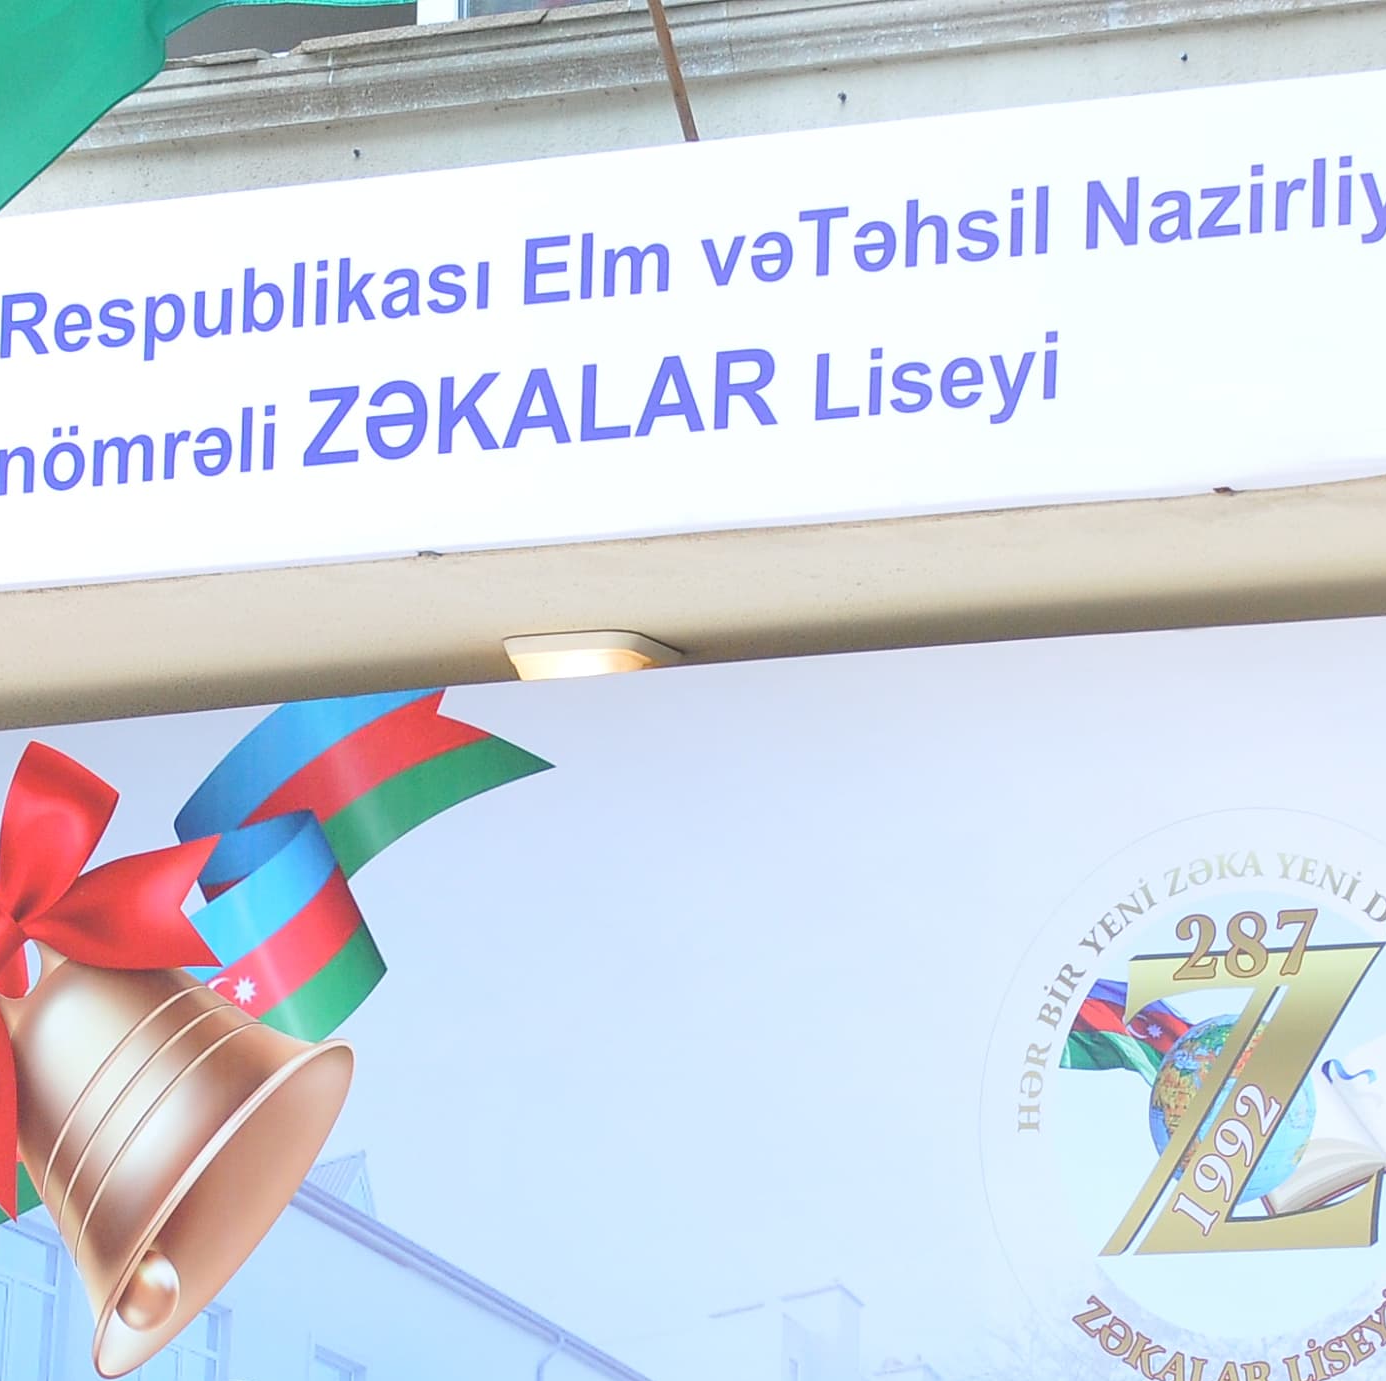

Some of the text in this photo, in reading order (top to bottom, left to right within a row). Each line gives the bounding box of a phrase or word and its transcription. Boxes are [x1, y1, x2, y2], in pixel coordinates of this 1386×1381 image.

[0, 257, 490, 361] Respublikası
[523, 231, 670, 305] Elm
[303, 349, 778, 469] ZƏKALAR
[814, 331, 1058, 425] Liseyi
[1017, 1041, 1053, 1133] HƏR
[1037, 963, 1087, 1031] BİR
[1078, 877, 1158, 957] YENİ
[1163, 850, 1264, 897] ZƏKA
[1277, 851, 1363, 903] YENİ
[1173, 907, 1318, 981] 287
[1173, 1084, 1282, 1236] 1992
